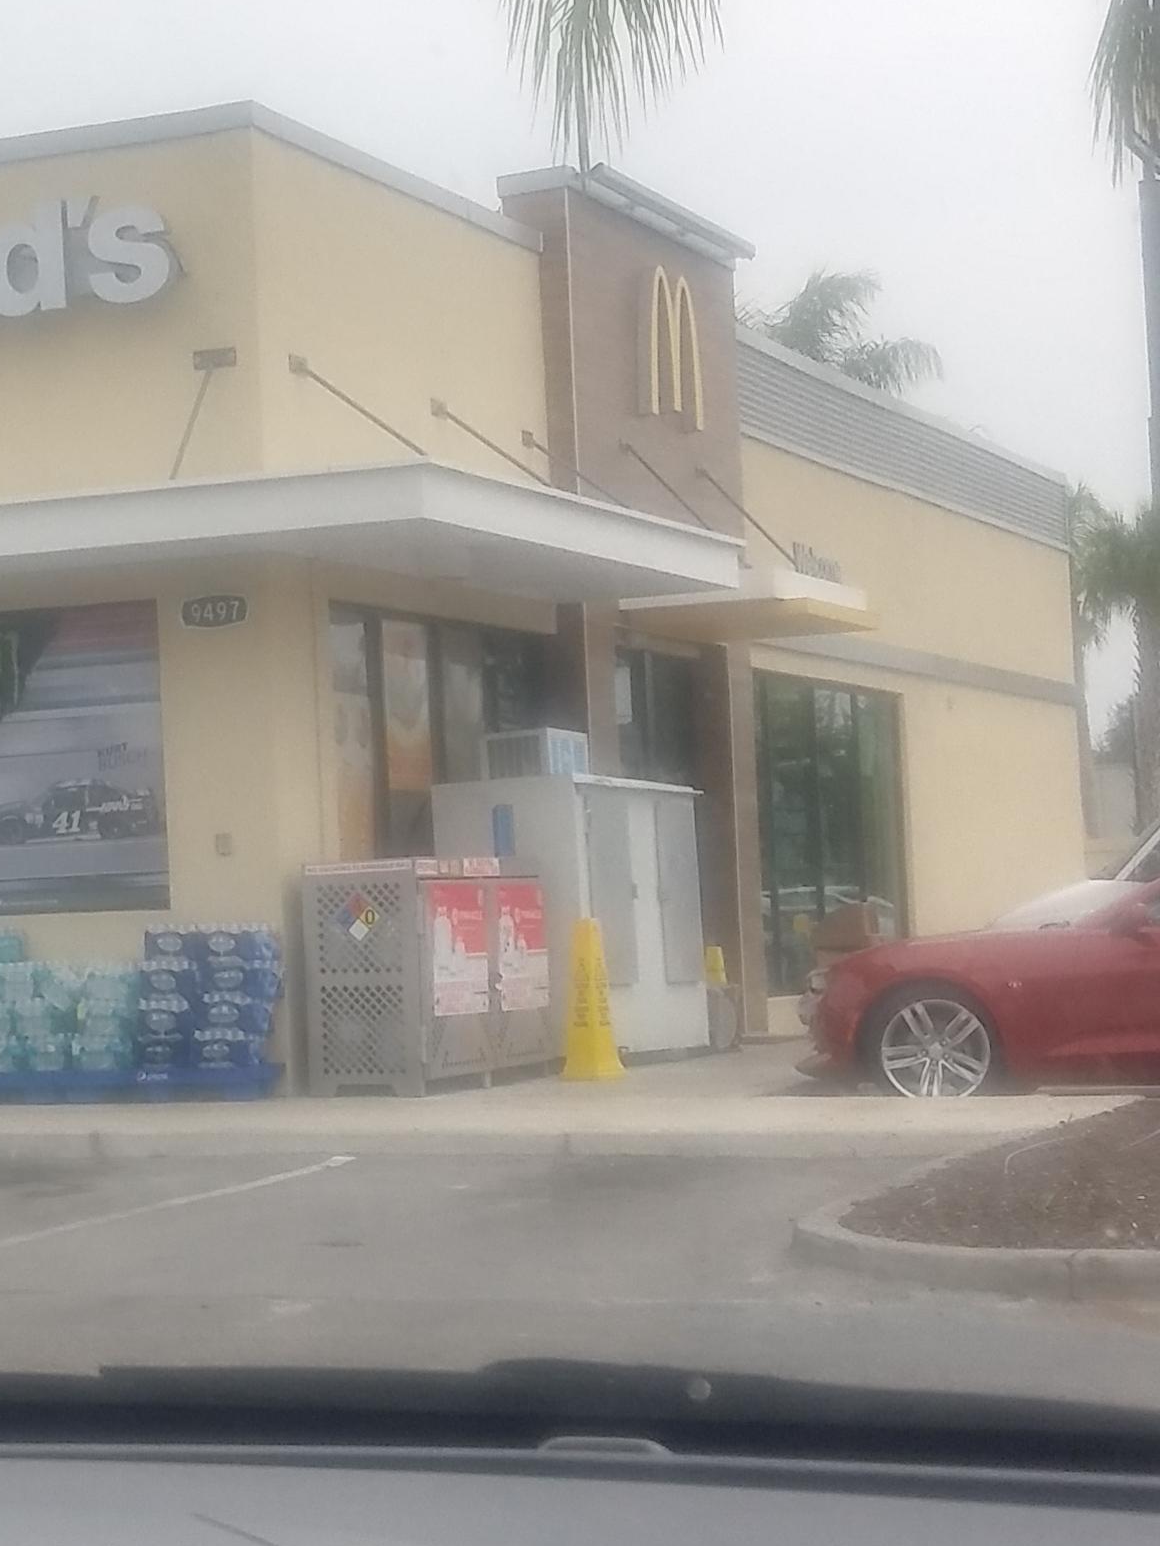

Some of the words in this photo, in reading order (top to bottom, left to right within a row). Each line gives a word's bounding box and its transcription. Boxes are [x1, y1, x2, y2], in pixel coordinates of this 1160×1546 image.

[191, 600, 240, 623] 9497
[52, 810, 81, 834] 41
[365, 909, 376, 925] 0
